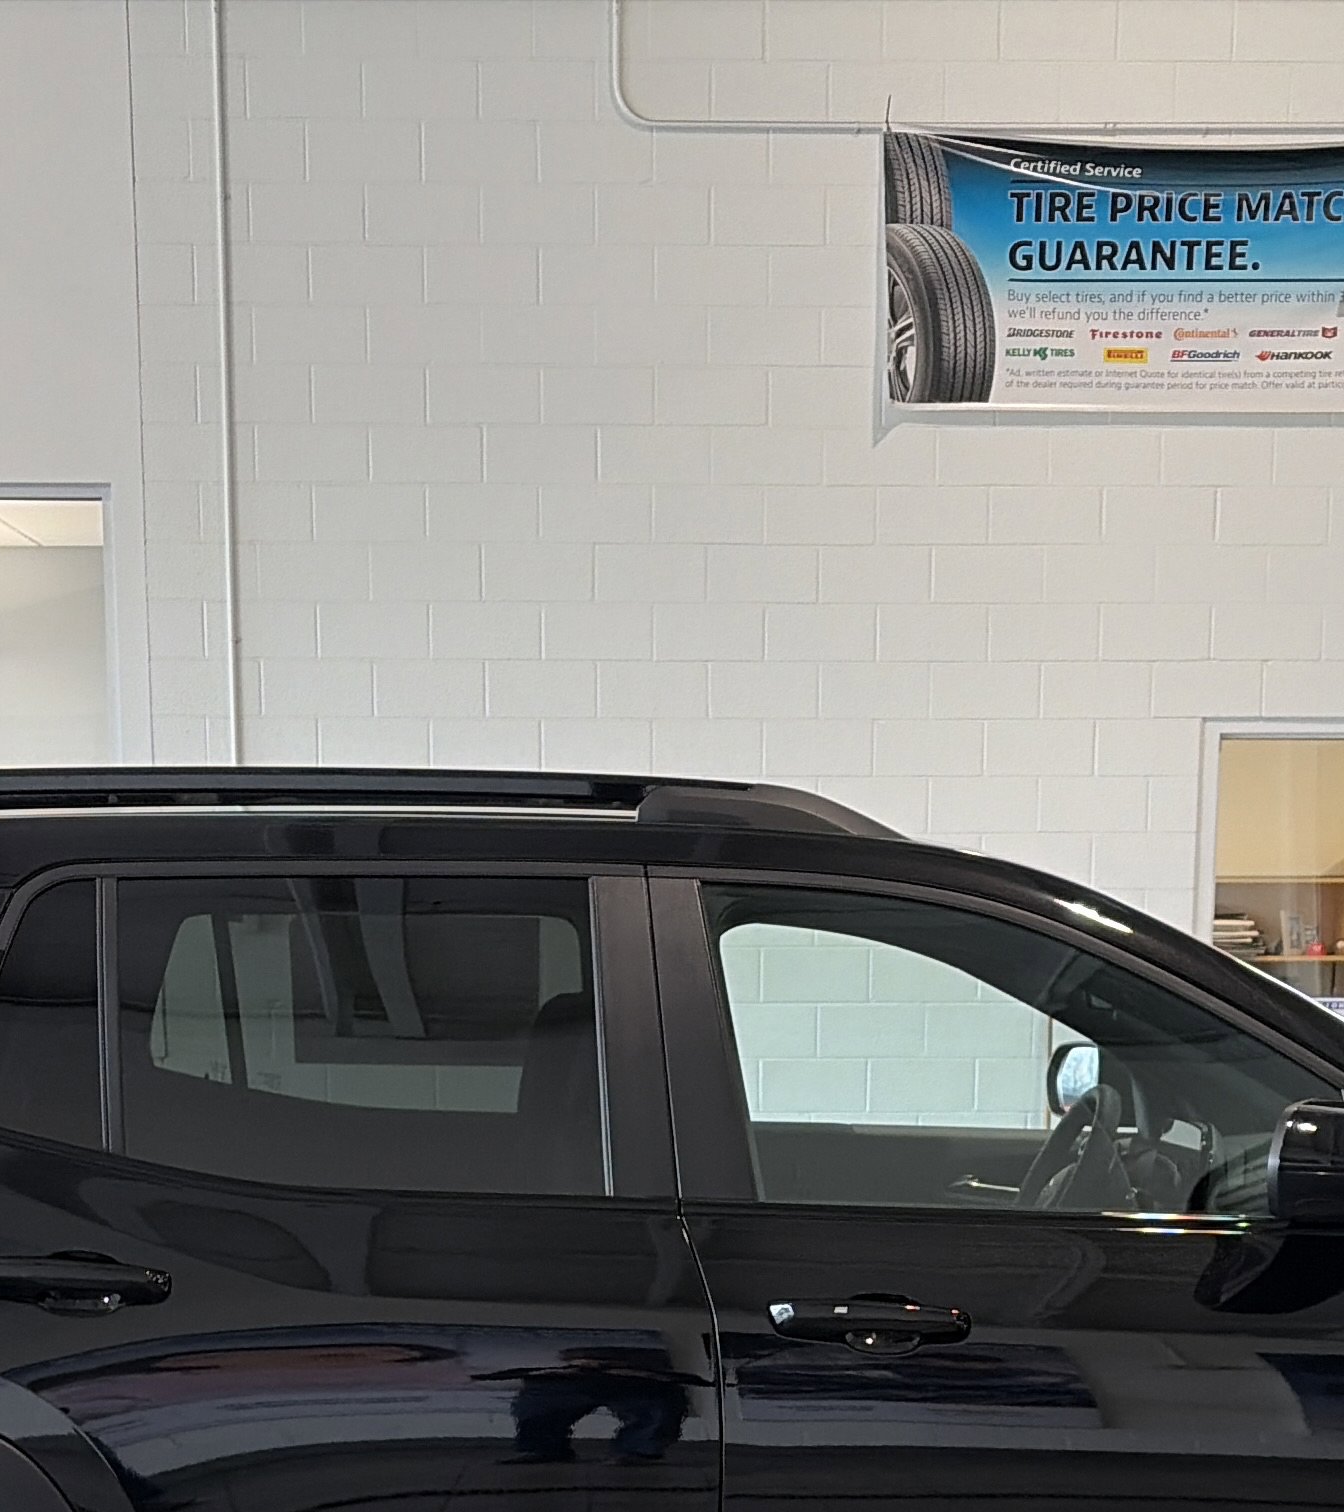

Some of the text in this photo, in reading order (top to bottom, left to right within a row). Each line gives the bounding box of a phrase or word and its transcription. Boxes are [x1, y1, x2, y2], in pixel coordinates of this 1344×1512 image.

[1009, 158, 1143, 179] Certified Service
[1009, 190, 1097, 223] TIRE
[1109, 190, 1223, 223] PRICE
[1008, 239, 1262, 272] GUARANTEE.
[1007, 288, 1031, 304] Buy
[1035, 290, 1071, 303] select
[1076, 291, 1106, 305] tires,
[1109, 290, 1134, 303] and
[1137, 290, 1147, 303] if
[1150, 292, 1174, 305] you
[1178, 290, 1204, 303] find
[1206, 293, 1215, 303] a
[1218, 290, 1258, 303] better
[1261, 290, 1292, 305] price
[1296, 290, 1335, 303] within
[1007, 306, 1036, 319] we'll
[1040, 307, 1081, 320] refund
[1085, 311, 1109, 323] you
[1112, 308, 1134, 320] the
[1006, 327, 1076, 339] BRIDGESTONE
[1089, 328, 1164, 340] Firestone
[1173, 328, 1231, 341] Continental
[1005, 347, 1032, 357] KELLY
[1050, 348, 1076, 357] TIRES
[1171, 350, 1241, 360] BFGoodrich
[1139, 369, 1165, 379] Quote
[1181, 370, 1216, 379] identical
[1272, 370, 1317, 379] competing
[1016, 380, 1029, 388] the
[1260, 380, 1284, 389] Offer
[1285, 380, 1306, 389] valid
